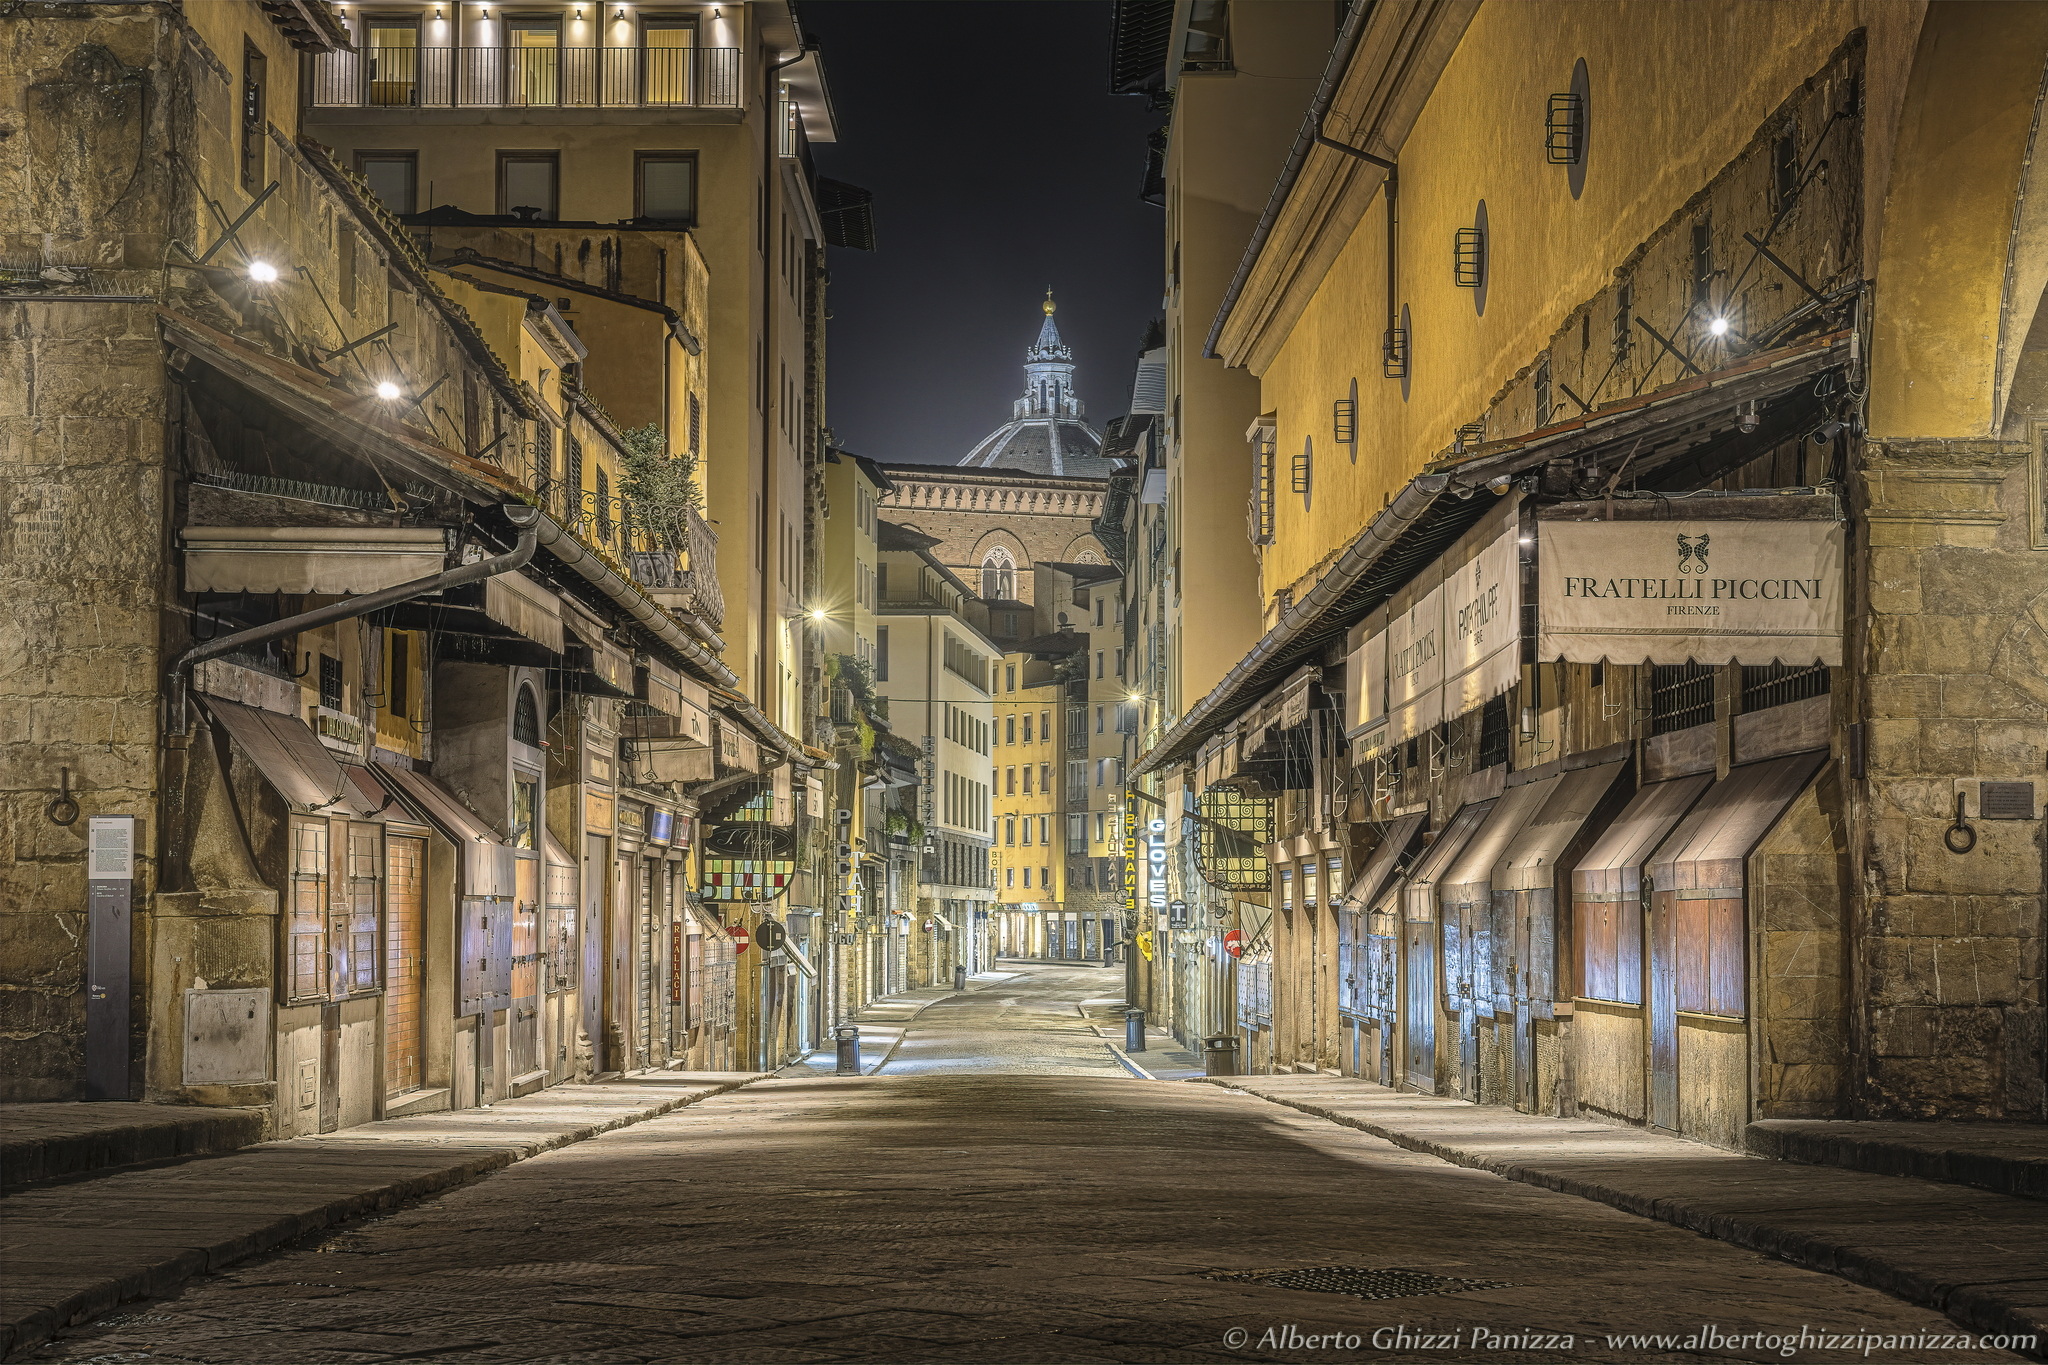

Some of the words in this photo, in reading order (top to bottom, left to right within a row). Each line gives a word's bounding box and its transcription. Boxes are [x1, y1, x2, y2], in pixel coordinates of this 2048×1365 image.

[1563, 576, 1704, 599] FRATELLI
[1711, 578, 1822, 600] PICCINI
[1667, 605, 1720, 616] FIRENZE
[836, 808, 852, 930] PICCINI
[1149, 819, 1166, 908] GLOVES
[832, 932, 854, 946] UGO
[673, 936, 681, 998] FALLACI
